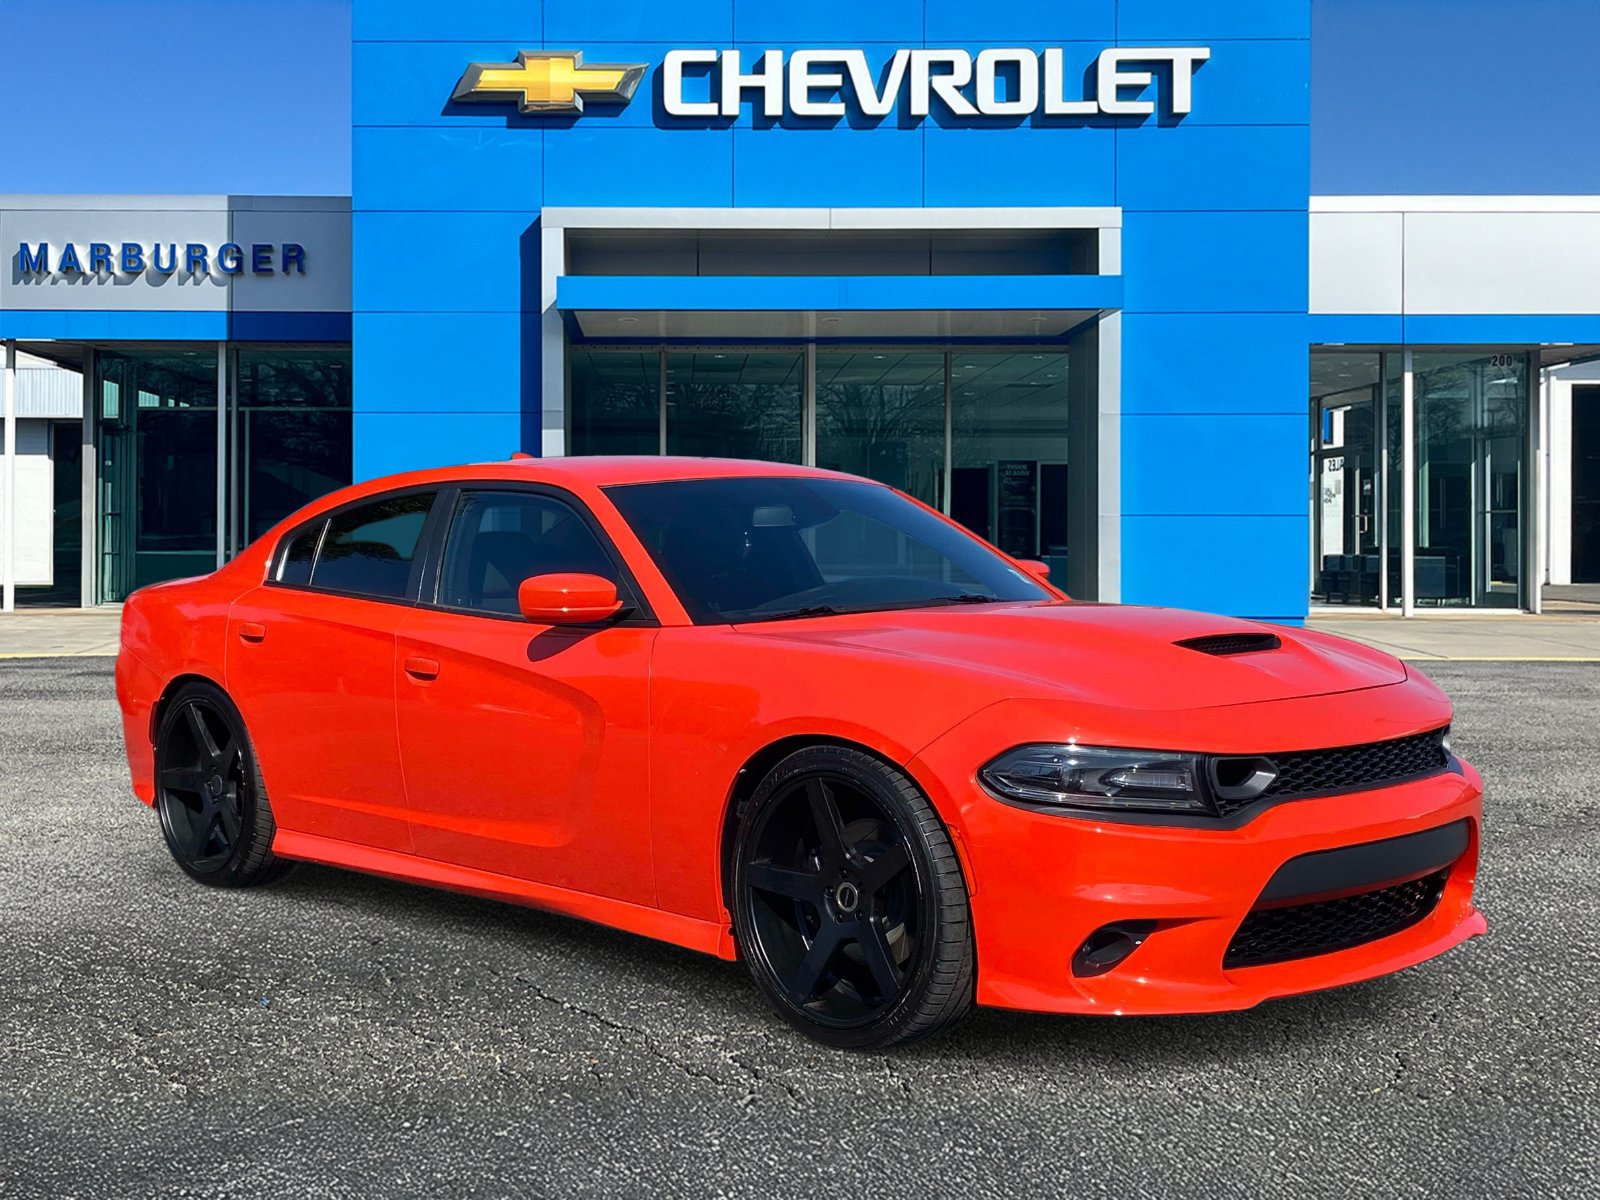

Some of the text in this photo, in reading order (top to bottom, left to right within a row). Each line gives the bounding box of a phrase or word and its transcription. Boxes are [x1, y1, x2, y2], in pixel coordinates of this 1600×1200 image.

[663, 47, 1211, 117] CHEVROLET
[19, 242, 305, 274] MARBURGER
[1491, 355, 1513, 367] 200
